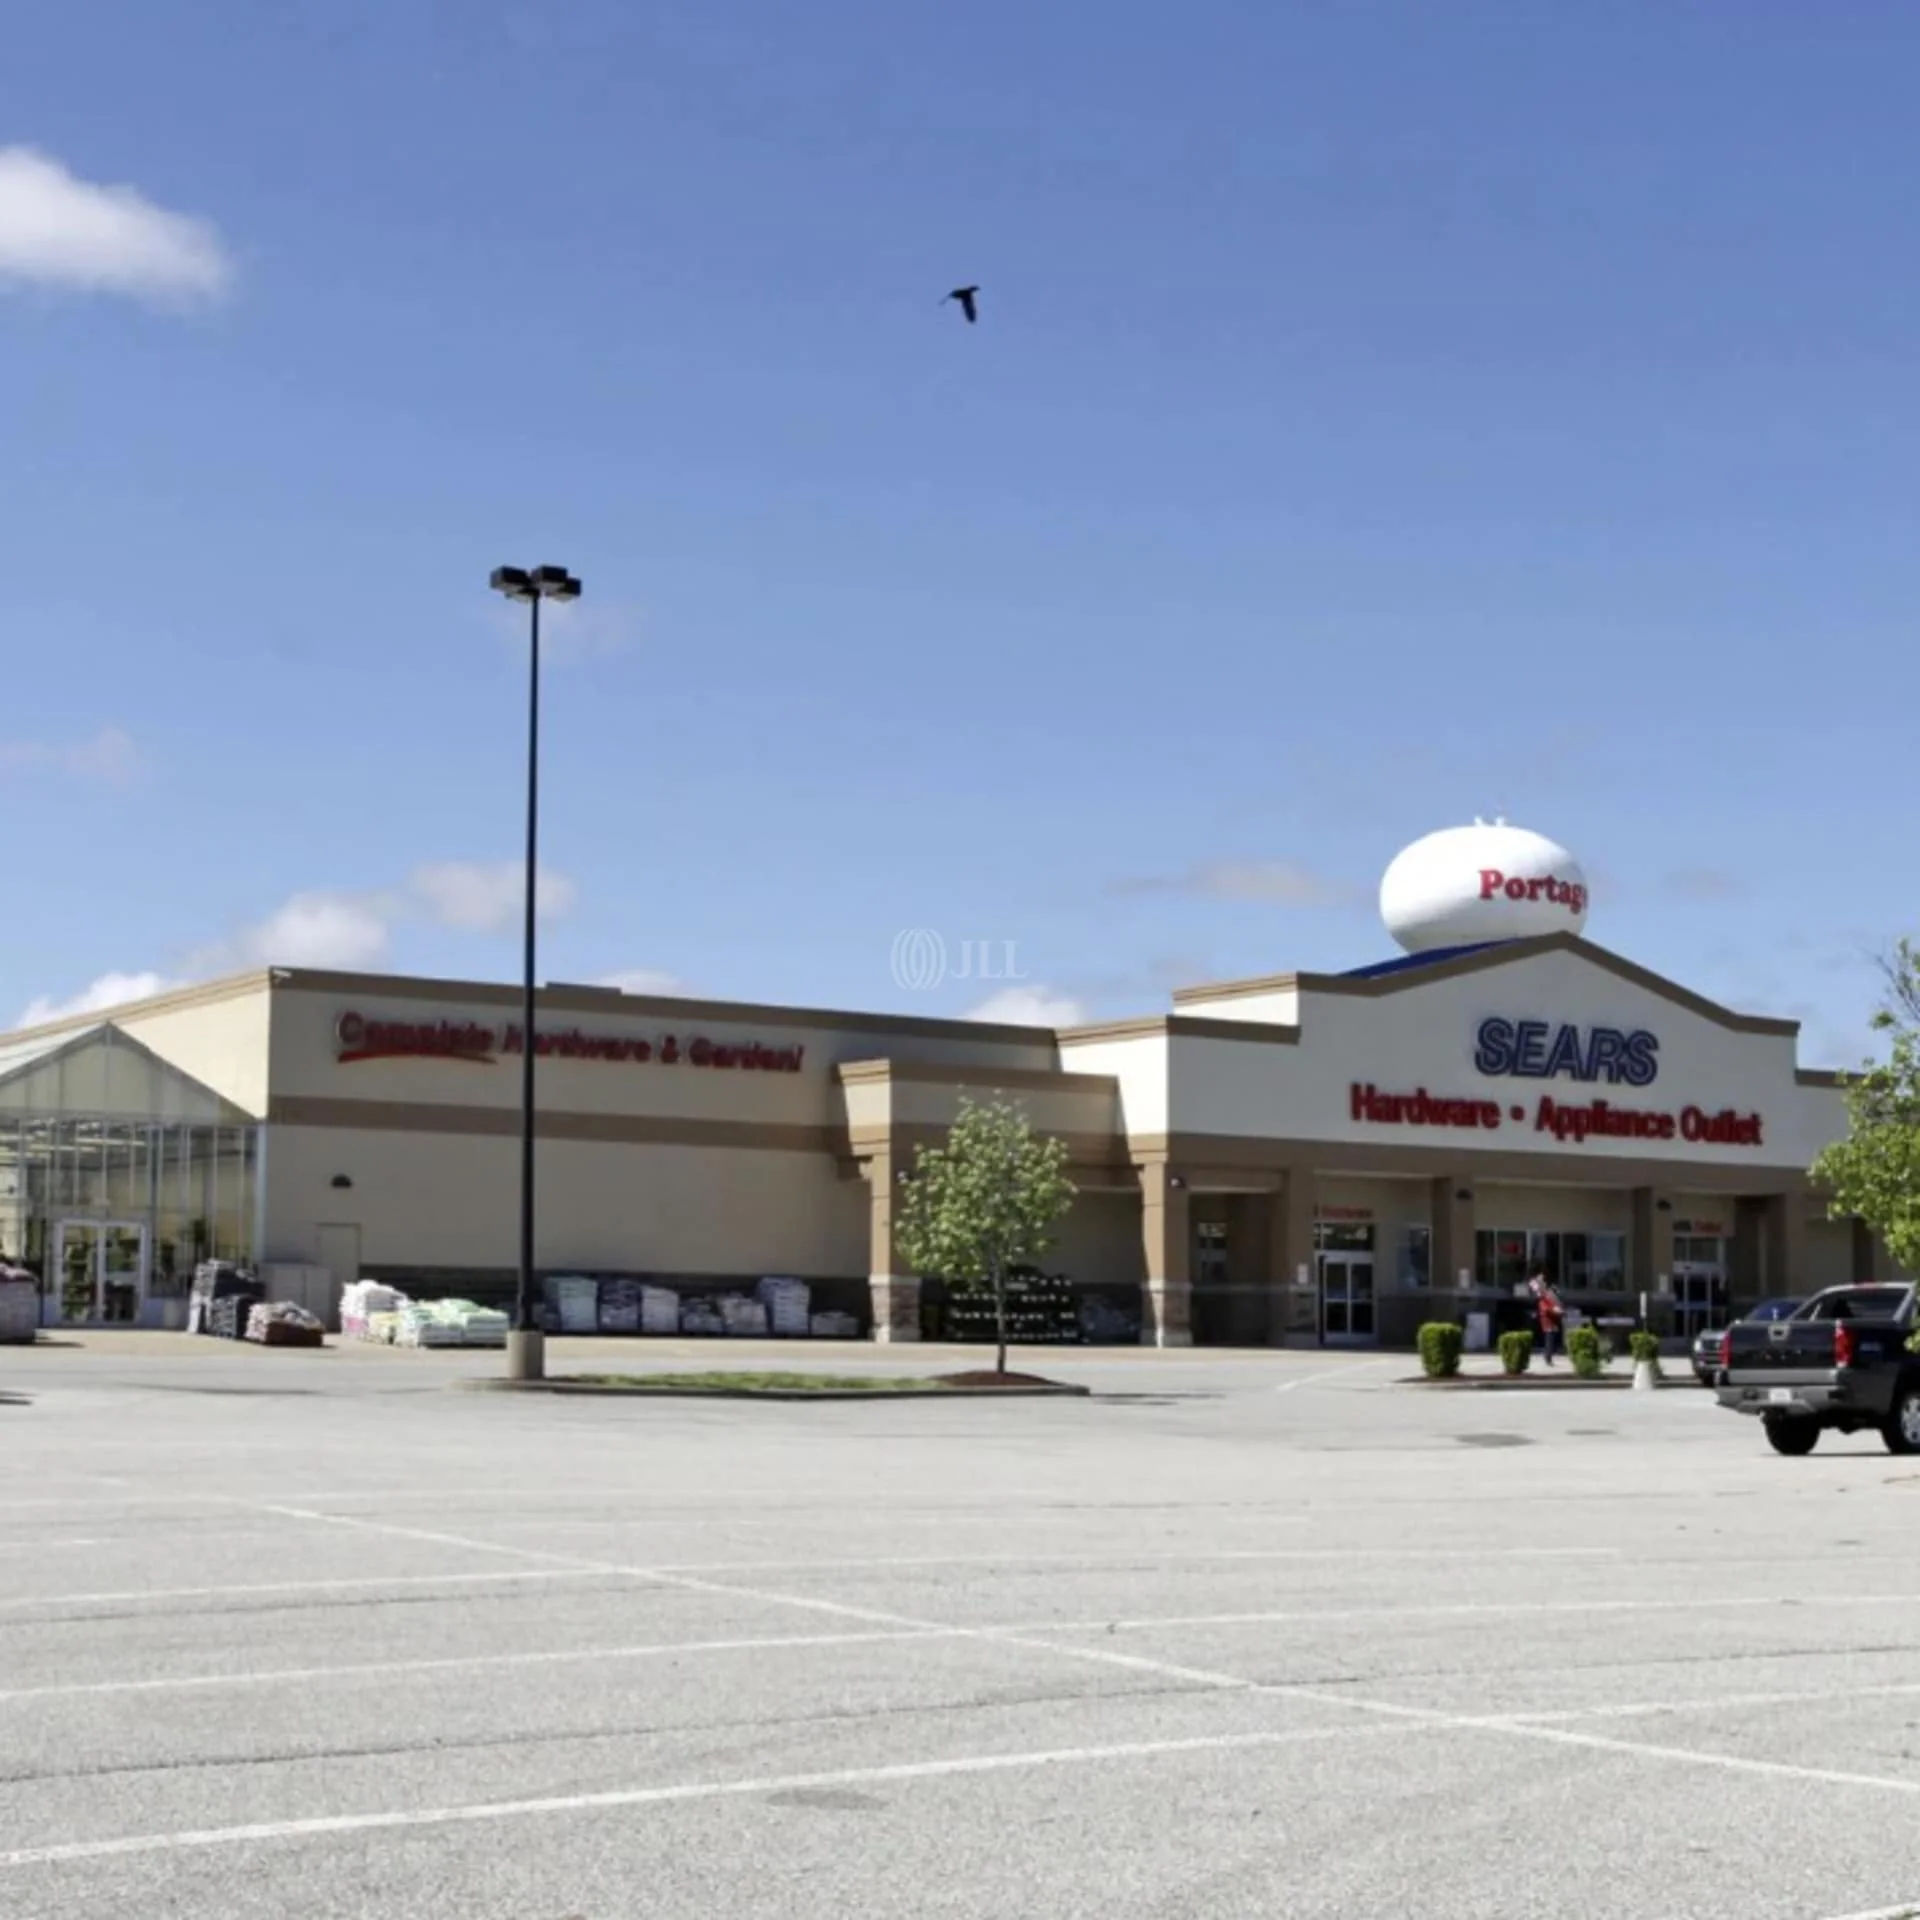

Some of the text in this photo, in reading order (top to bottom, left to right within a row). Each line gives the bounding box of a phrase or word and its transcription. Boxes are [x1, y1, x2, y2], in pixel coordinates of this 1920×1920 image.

[1475, 1016, 1660, 1087] SEARS
[1350, 1082, 1763, 1147] Hardware Appliance Outlet
